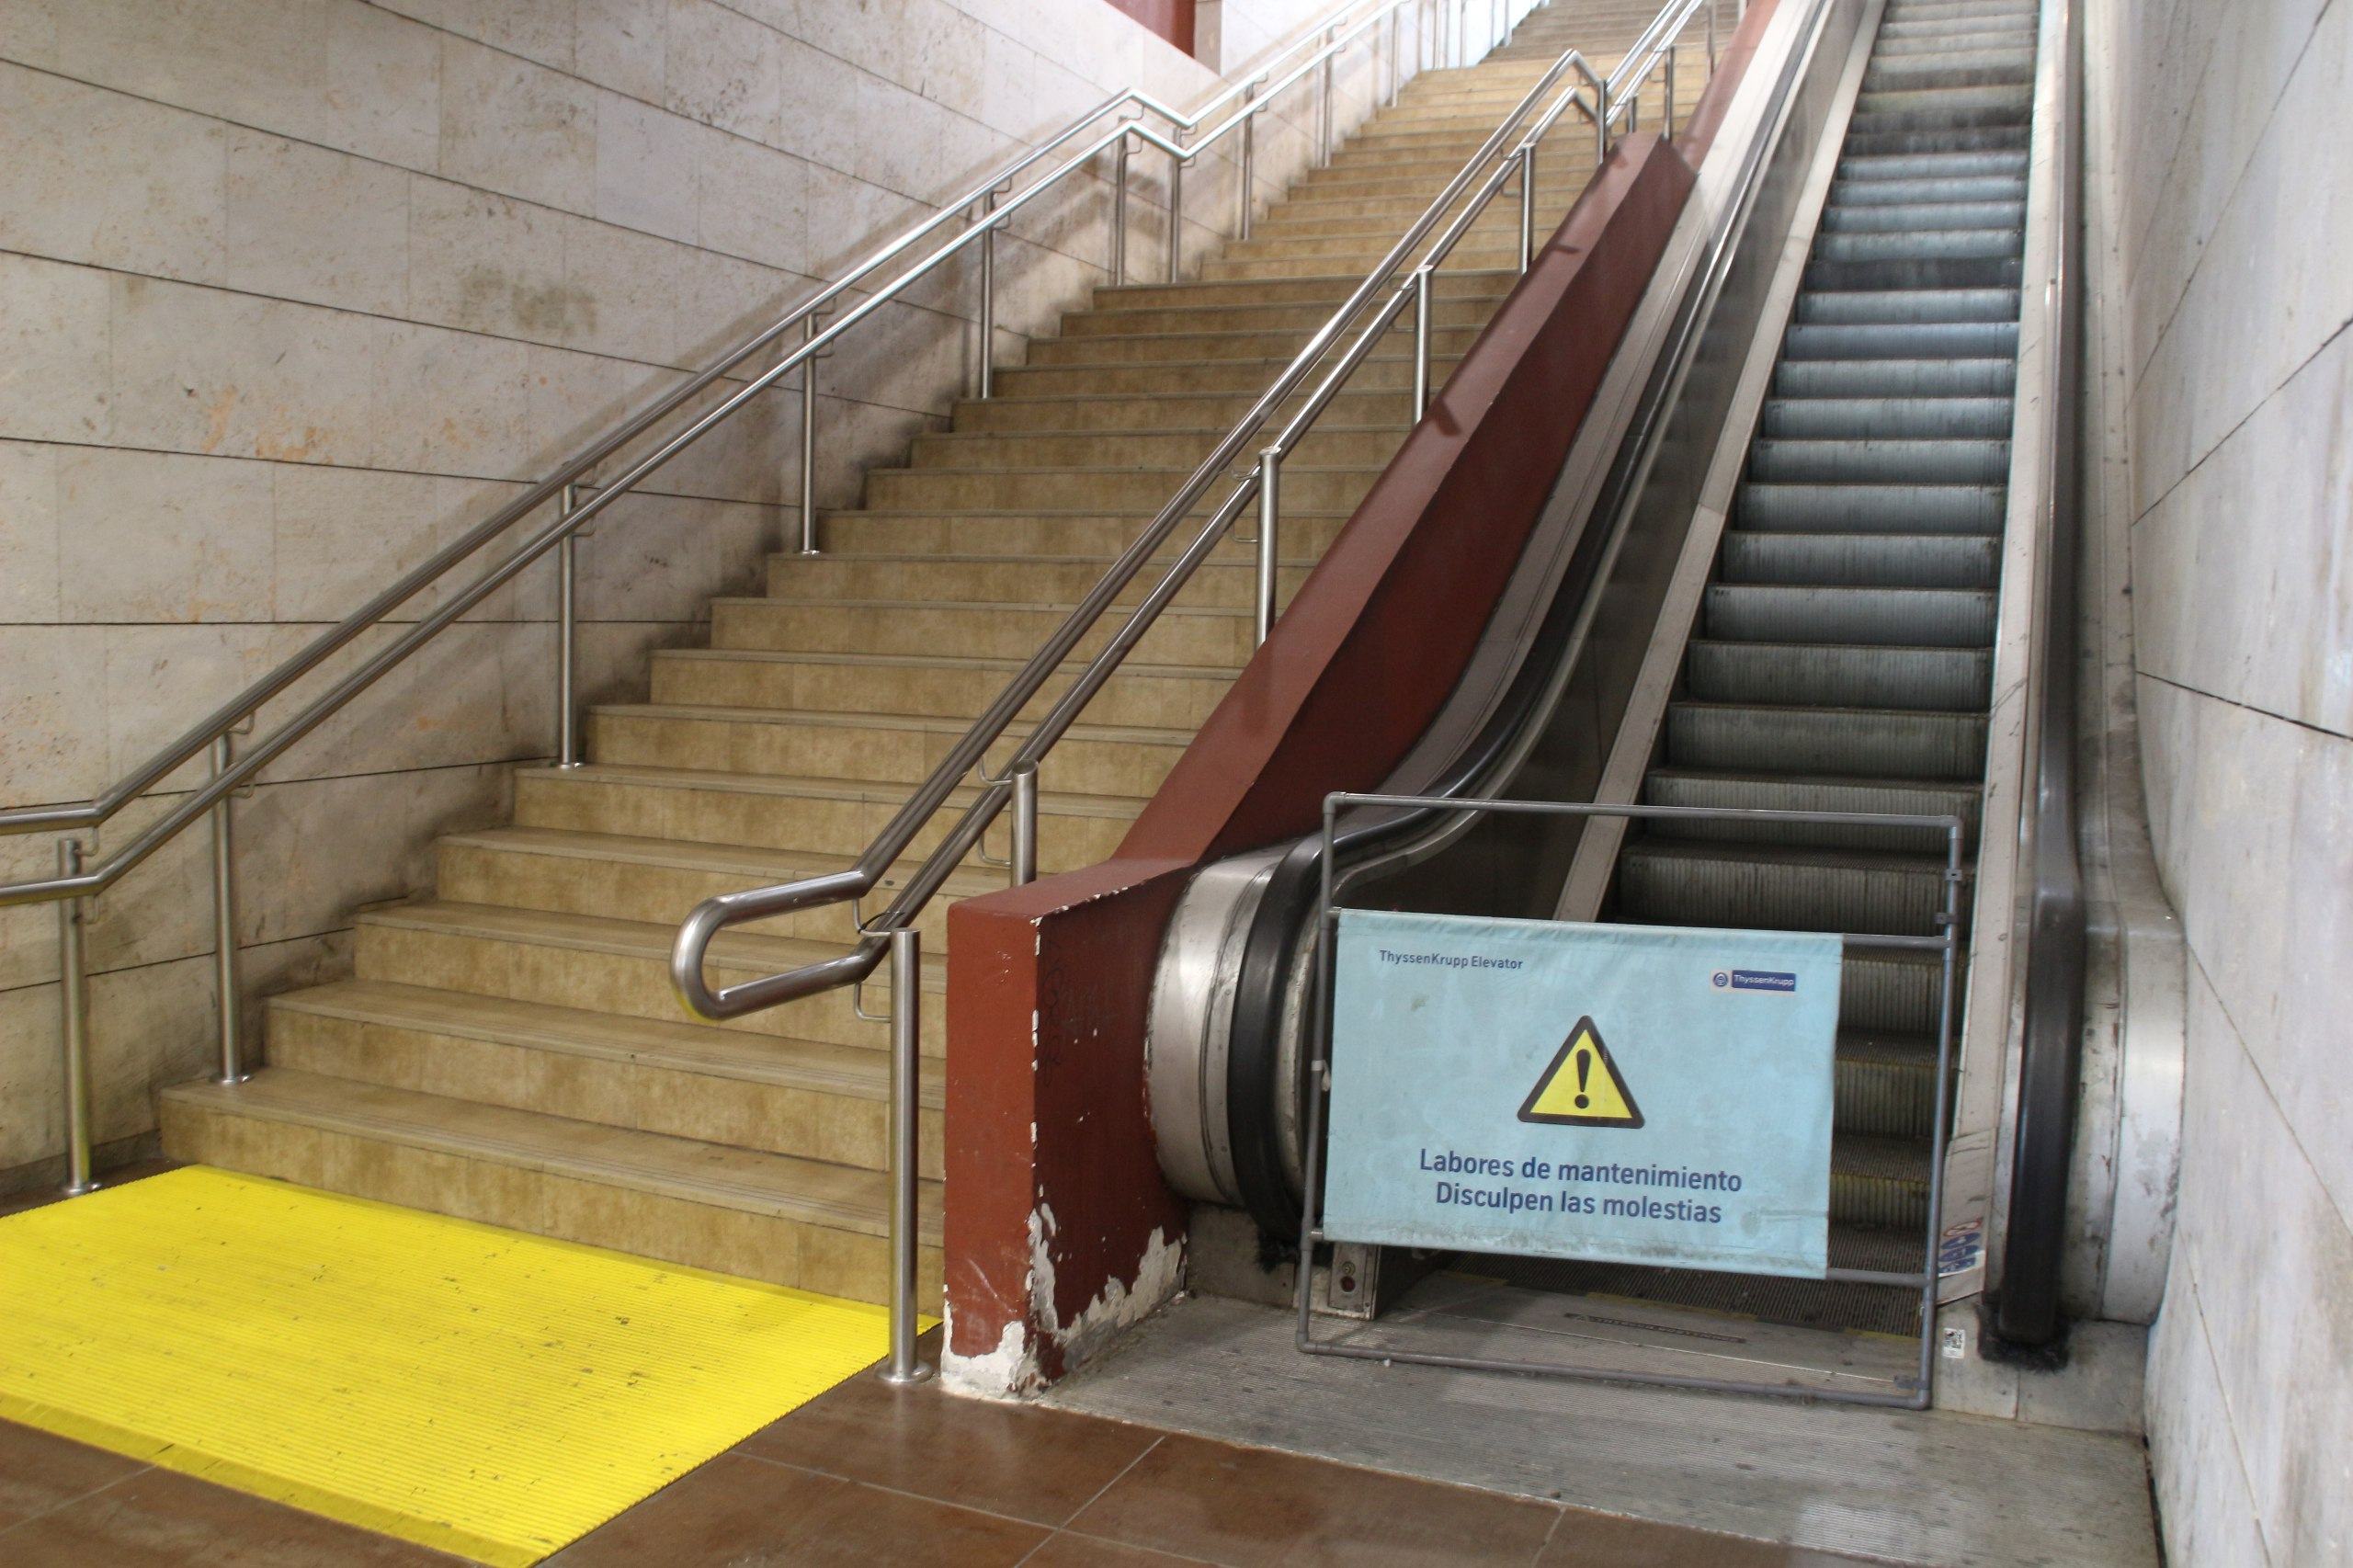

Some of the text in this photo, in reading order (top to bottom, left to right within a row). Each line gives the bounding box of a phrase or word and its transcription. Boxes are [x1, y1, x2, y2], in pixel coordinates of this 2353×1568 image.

[1380, 949, 1523, 970] ThyssenKrupp Elevator
[1733, 974, 1794, 986] ThyssenKrupp
[1420, 1149, 1743, 1192] Labores de mantenimiento
[1436, 1182, 1722, 1224] Disculpen las molestias
